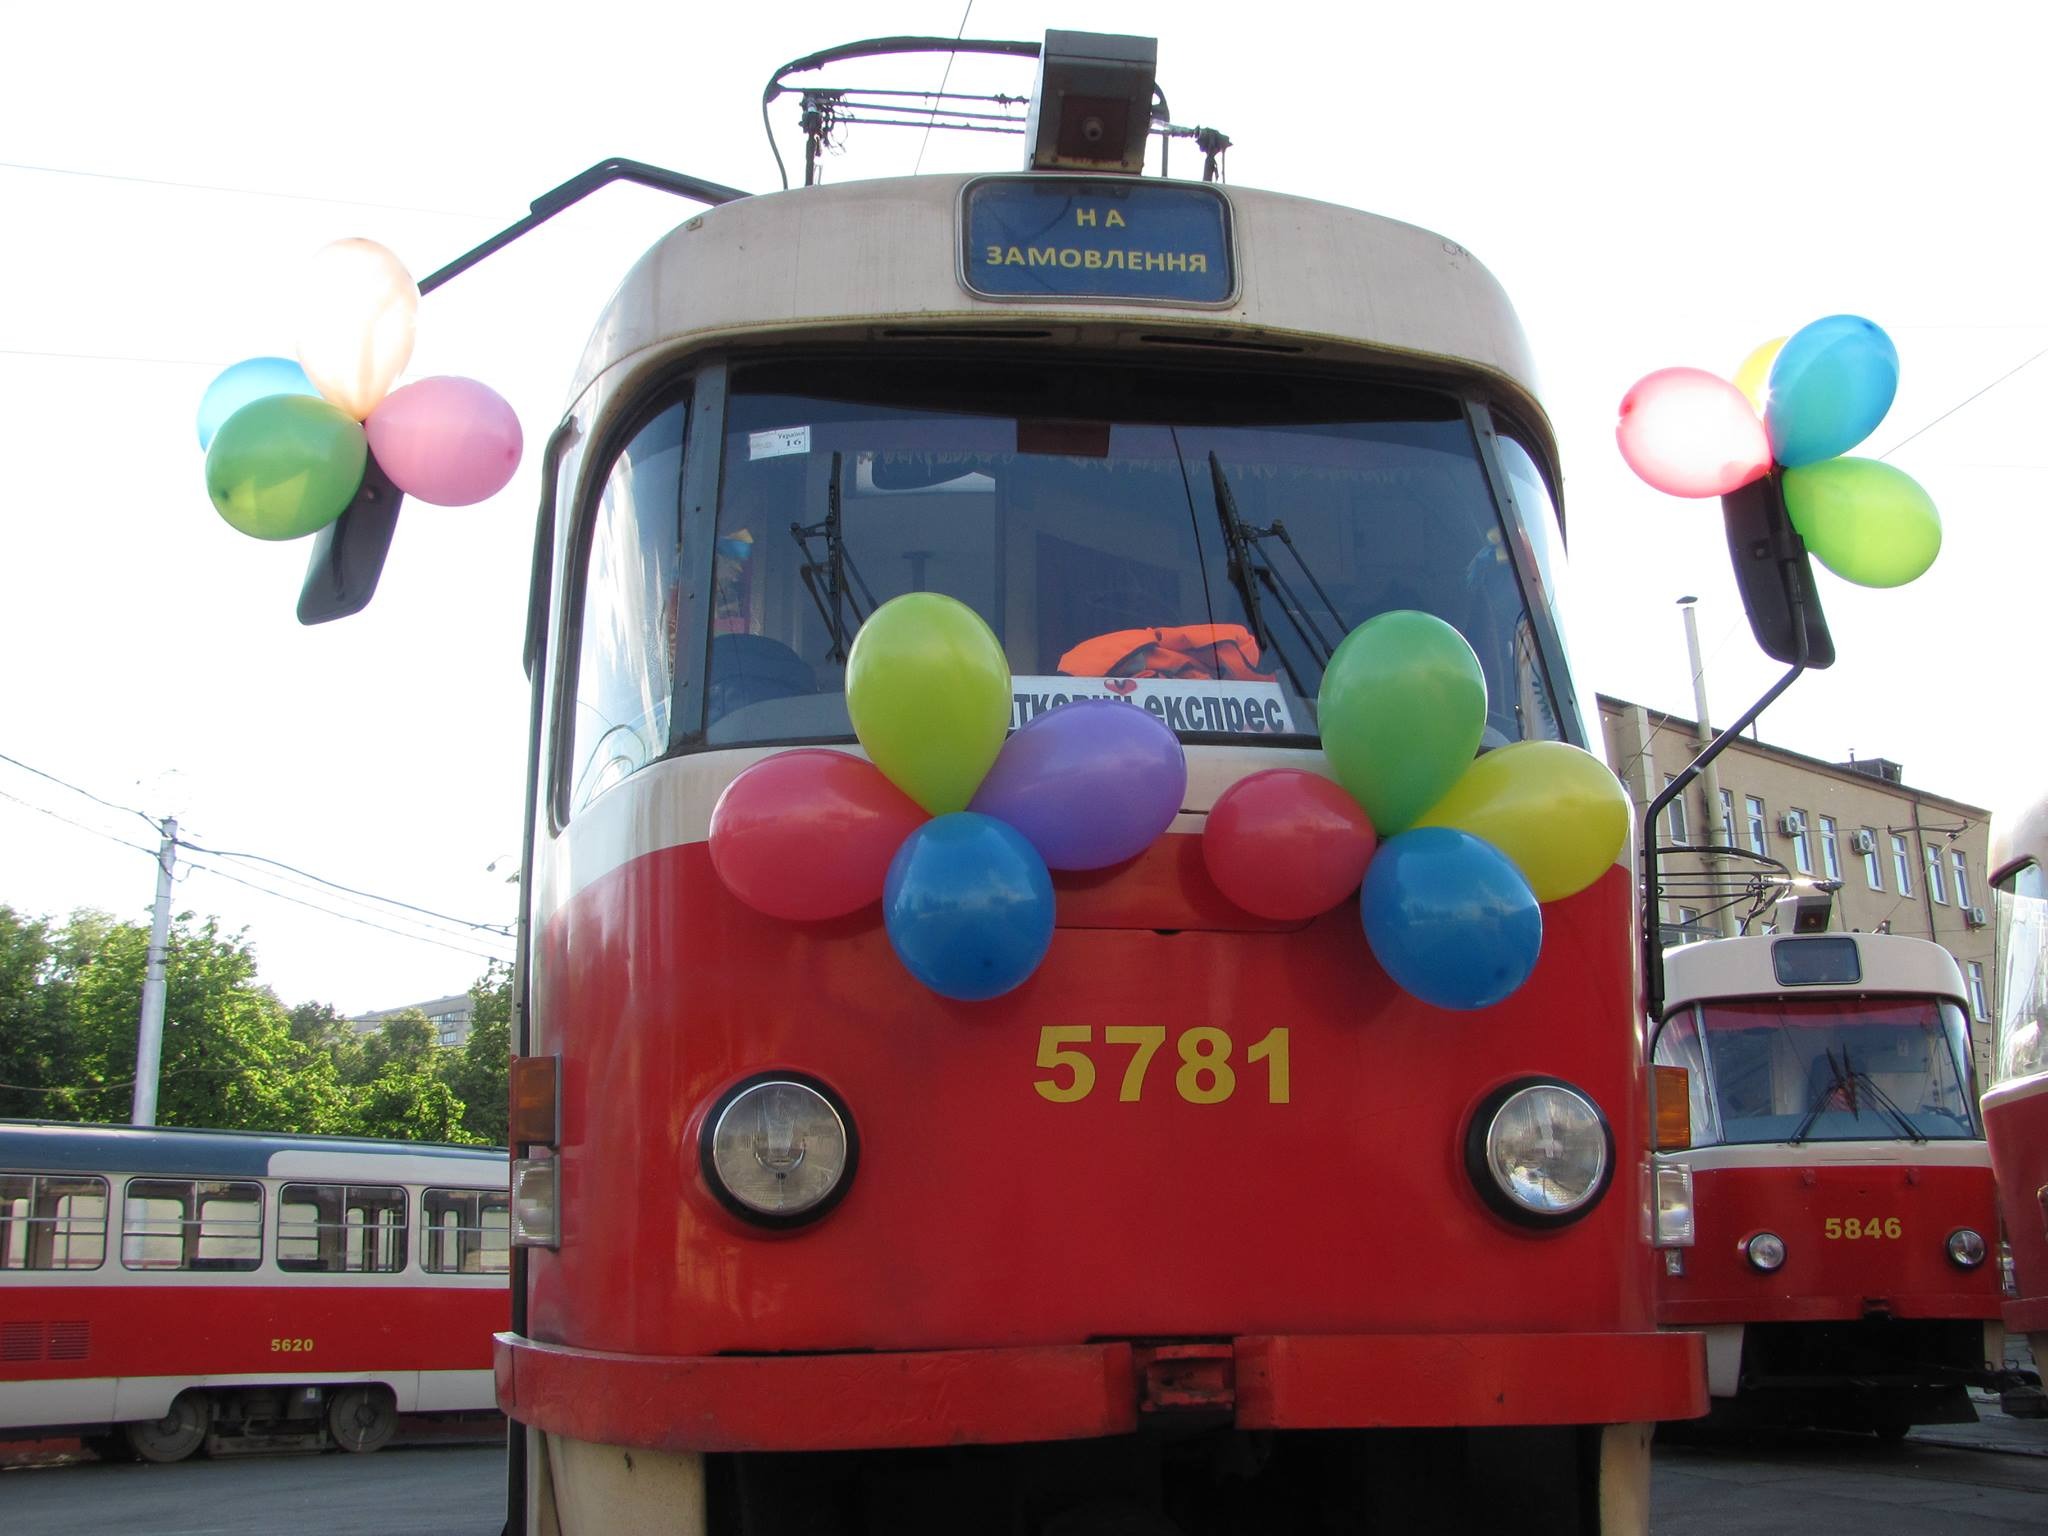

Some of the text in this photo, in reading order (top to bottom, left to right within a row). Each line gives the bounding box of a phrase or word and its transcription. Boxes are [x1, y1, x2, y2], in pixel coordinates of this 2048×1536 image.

[1076, 207, 1126, 227] НА
[986, 246, 1207, 273] ЗАМОВЛЕННЯ
[1144, 694, 1284, 733] експрес
[1033, 1024, 1290, 1104] 5781
[1824, 1217, 1902, 1239] 5846
[271, 1338, 314, 1352] 5620
